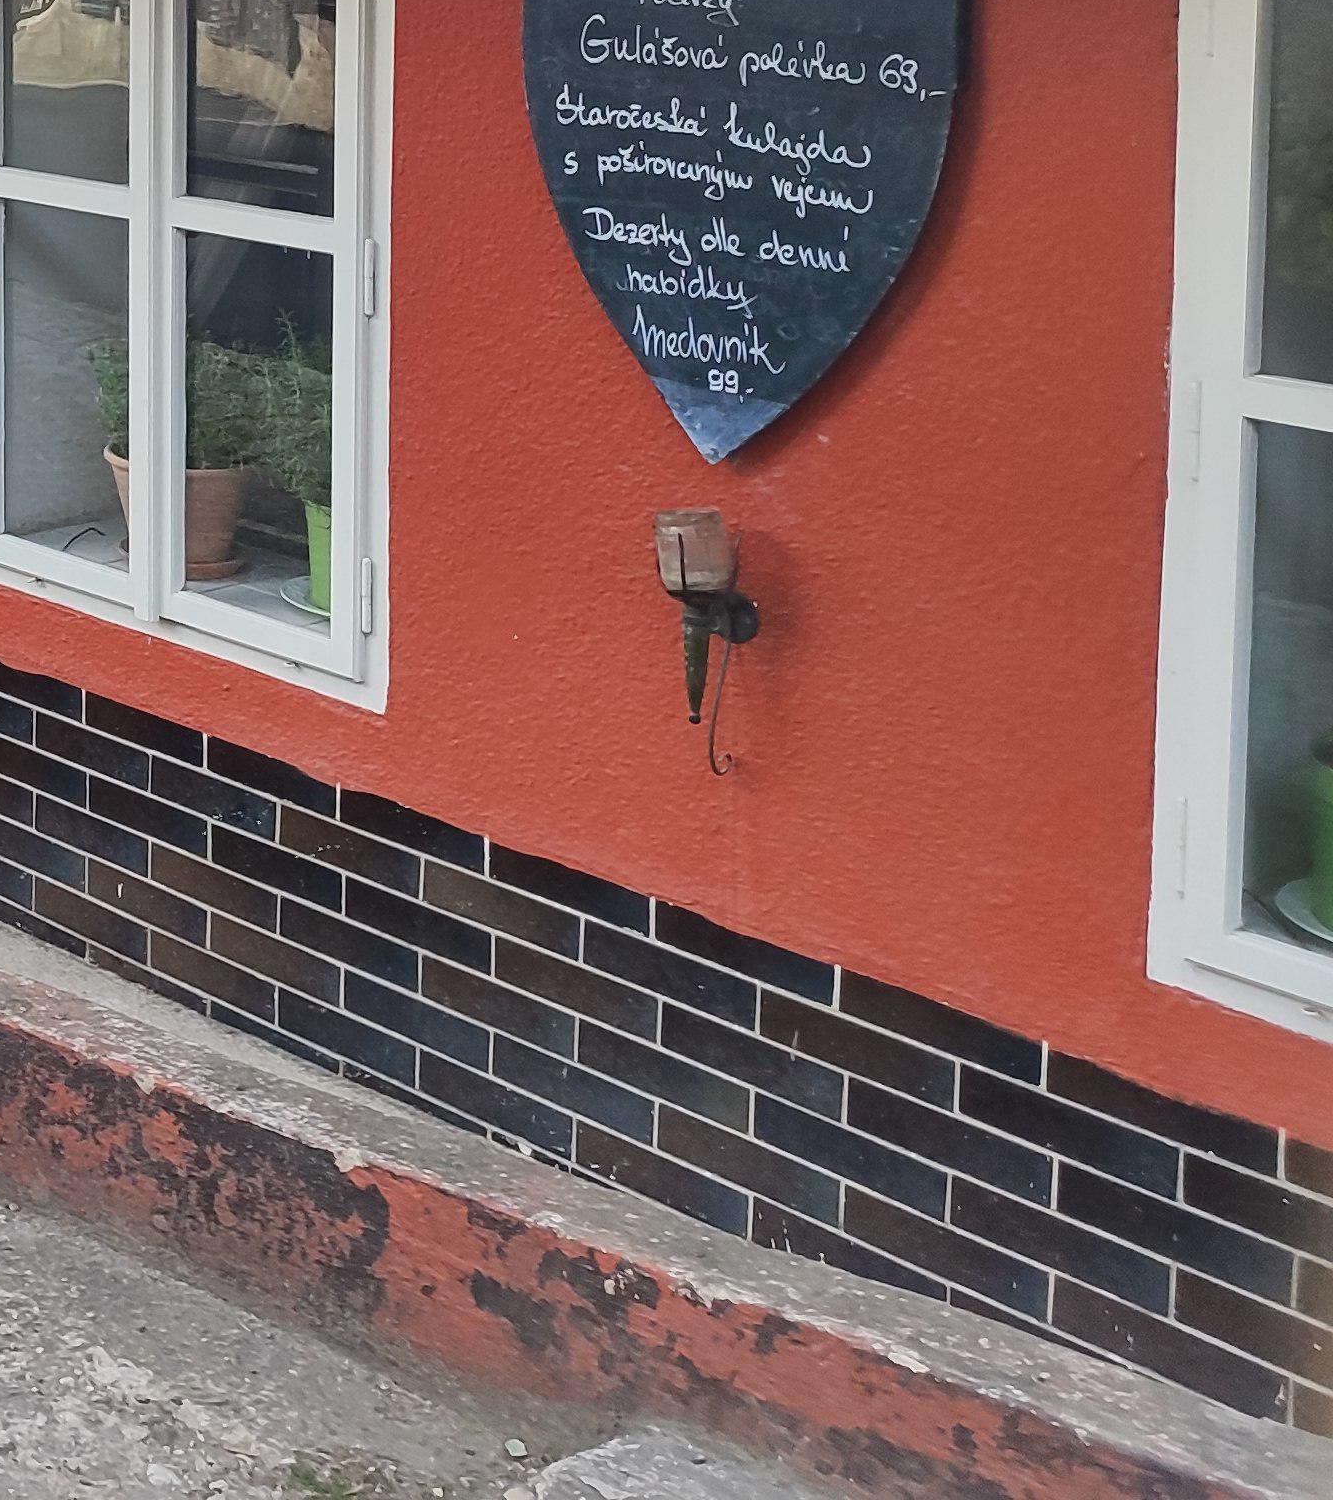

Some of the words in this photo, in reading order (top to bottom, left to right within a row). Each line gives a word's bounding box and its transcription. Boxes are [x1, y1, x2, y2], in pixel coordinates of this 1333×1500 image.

[580, 13, 729, 70] Gulášová
[555, 80, 709, 137] Staročeská
[582, 206, 692, 266] Dezerty
[700, 216, 746, 257] dle
